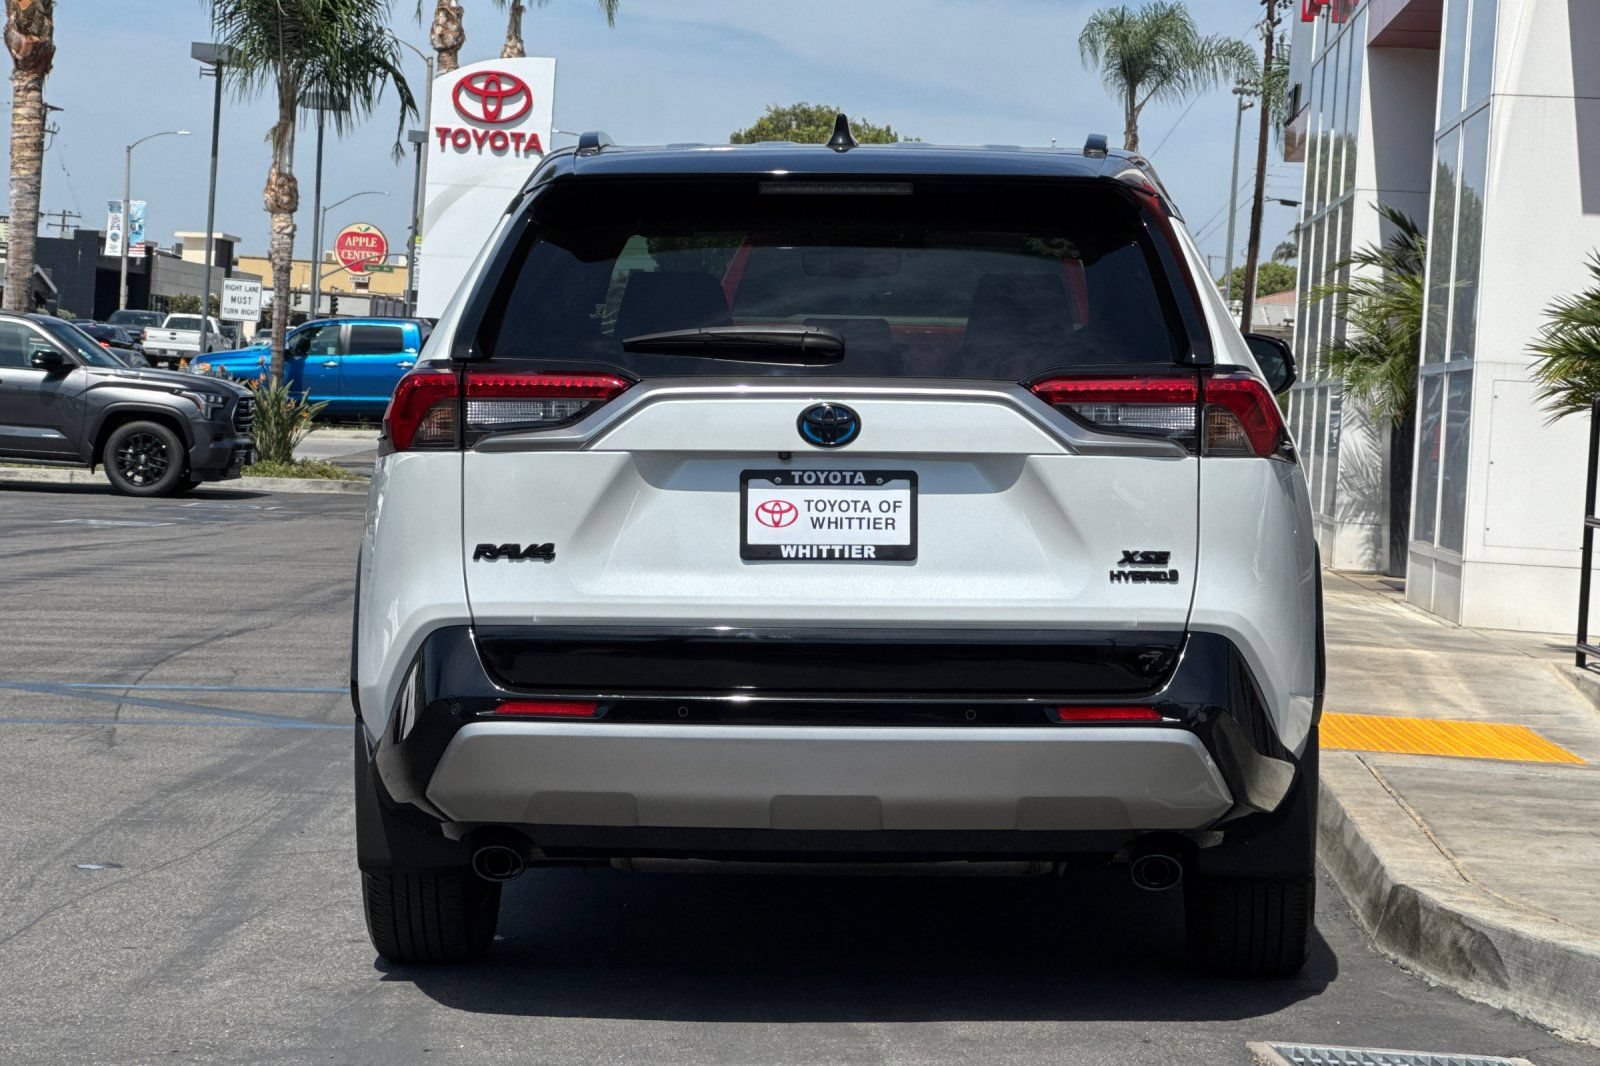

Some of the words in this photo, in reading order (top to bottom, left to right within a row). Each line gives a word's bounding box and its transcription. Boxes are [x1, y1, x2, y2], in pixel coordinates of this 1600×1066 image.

[435, 127, 544, 155] TOYOTA
[345, 236, 378, 248] APPLE
[341, 249, 379, 262] CENTER
[225, 284, 243, 292] RIGHT
[231, 295, 252, 305] MUST
[223, 307, 239, 315] TURN
[240, 309, 258, 317] RIGHT
[791, 471, 867, 485] TOYOTA
[804, 500, 872, 513] TOYOTA
[878, 500, 902, 513] OF
[810, 517, 896, 531] WHITTIER
[473, 543, 556, 561] RAV4
[780, 545, 876, 559] WHITTIER
[1117, 550, 1171, 565] XSE
